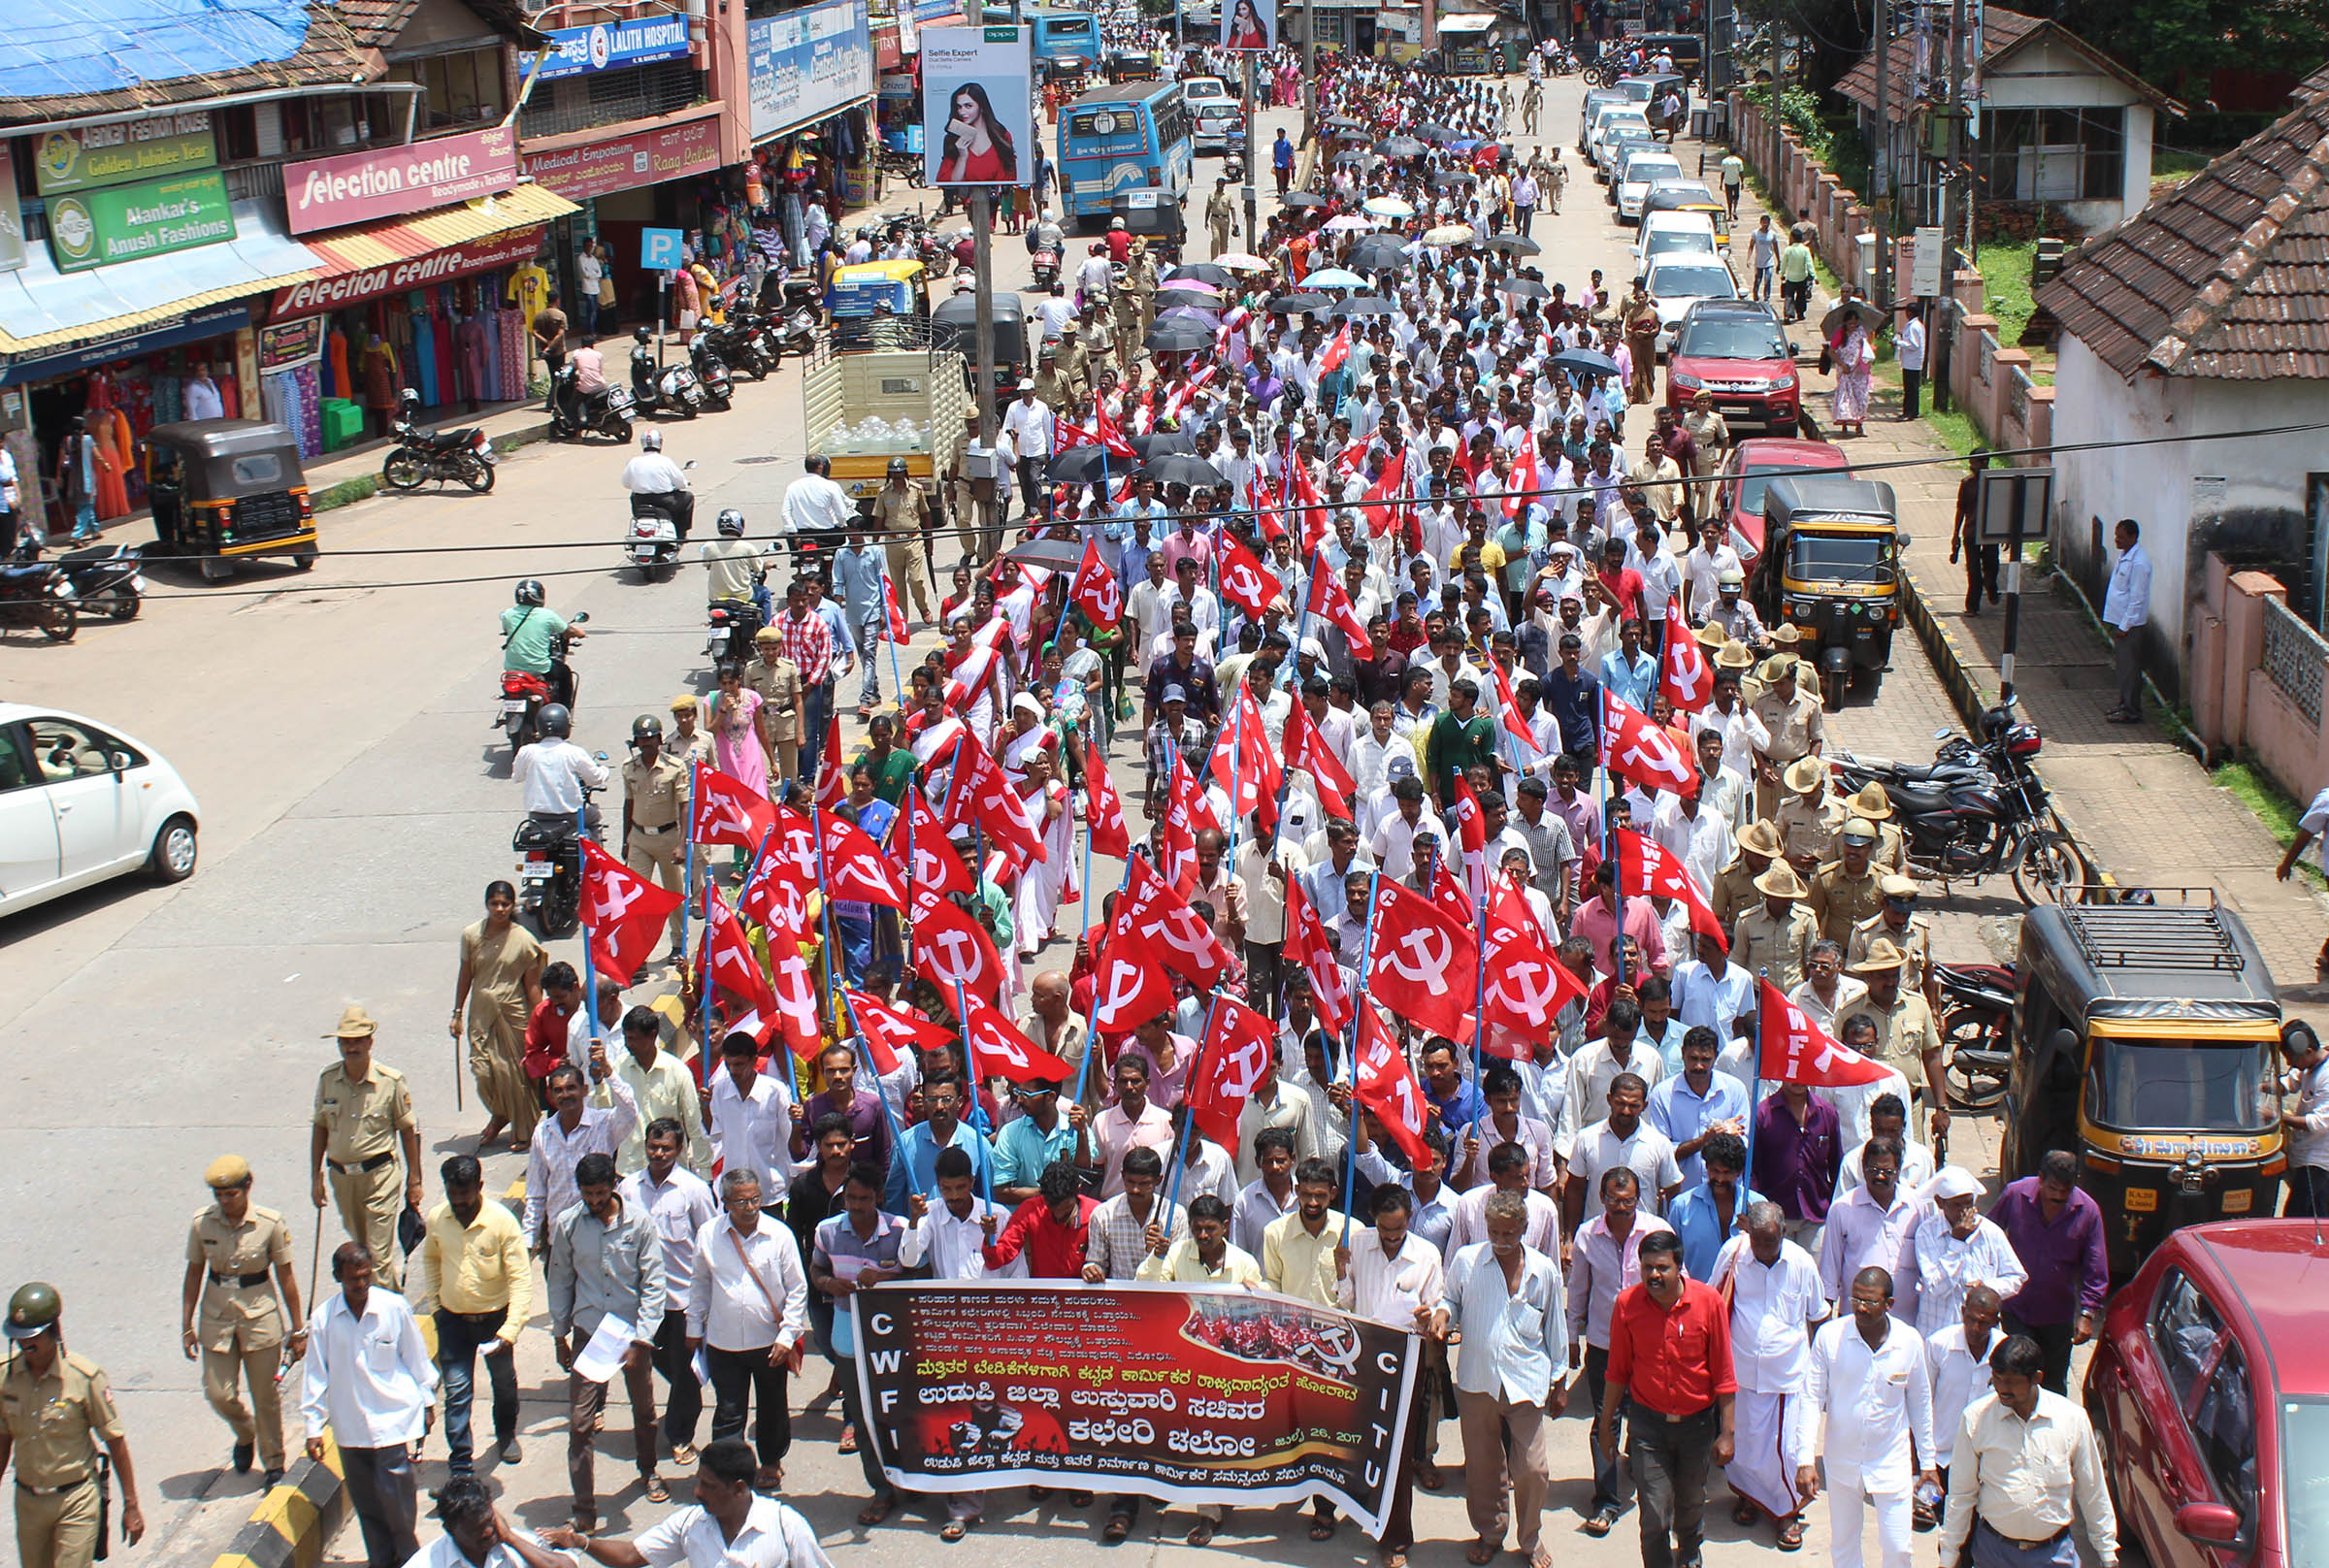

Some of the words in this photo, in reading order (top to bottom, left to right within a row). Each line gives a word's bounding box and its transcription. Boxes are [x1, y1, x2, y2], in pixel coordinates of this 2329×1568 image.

[610, 30, 642, 53] LALITH
[644, 21, 685, 49] HOSPITAL
[928, 49, 951, 58] Selfie
[952, 49, 978, 58] Expert
[88, 156, 132, 178] Golden
[135, 147, 179, 170] Jubilee
[181, 143, 209, 162] Year
[531, 152, 580, 175] Medical
[582, 144, 634, 164] Emporium
[652, 152, 681, 174] Raag
[683, 145, 716, 167] Lalith
[299, 163, 402, 211] Selection
[407, 152, 472, 185] centre
[431, 177, 479, 200] Readymade
[484, 172, 512, 189] Textiles
[55, 219, 91, 236] ANUSH
[126, 198, 200, 226] Alankar's
[108, 231, 157, 257] Anush
[160, 219, 228, 249] Fashions
[649, 234, 672, 262] P
[277, 266, 389, 315] Selection
[393, 250, 463, 285] centre
[461, 251, 506, 269] Readymade
[510, 244, 538, 257] Textiles
[916, 1358, 968, 1380] ಮತ್ತಿತರ
[974, 1360, 1070, 1380] ಬೇಡಿಕೆಗಳಿಗಾಗಿ
[1077, 1366, 1114, 1388] ಕಟ್ಟಡ
[1121, 1366, 1192, 1386] ಕಾರ್ಮಿಕರ
[1197, 1372, 1291, 1398] ರಾಜ್ಯದಾದ್ಯಂತ
[1296, 1376, 1359, 1401] ಹೋರಾಟ
[918, 1381, 996, 1404] ಉಡುಪಿ
[1005, 1383, 1062, 1409] ಜಿಲ್ಲಾ
[1070, 1386, 1178, 1416] ಉಸ್ತುವಾರಿ
[1188, 1396, 1265, 1421] ಸಚಿವರ
[1067, 1417, 1156, 1447] ಕಛೇರಿ
[1167, 1428, 1256, 1457] ಚಲೋ
[1275, 1427, 1305, 1448] ಜುಲೈ
[1335, 1430, 1362, 1444] 2017
[1363, 1351, 1398, 1488] CITU
[924, 1455, 963, 1468] ಉಡುಪಿ
[1001, 1451, 1031, 1468] ಕಟ್ಟಡ
[1034, 1454, 1060, 1468] ಮತ್ತು
[1097, 1456, 1149, 1471] ನಿರ್ಮಾಣ
[1154, 1463, 1207, 1482] ಕಾರ್ಮಿಕರ
[1212, 1470, 1269, 1486] ಸಮನ್ವಯ
[1310, 1463, 1345, 1485] ಉಡುಪಿ
